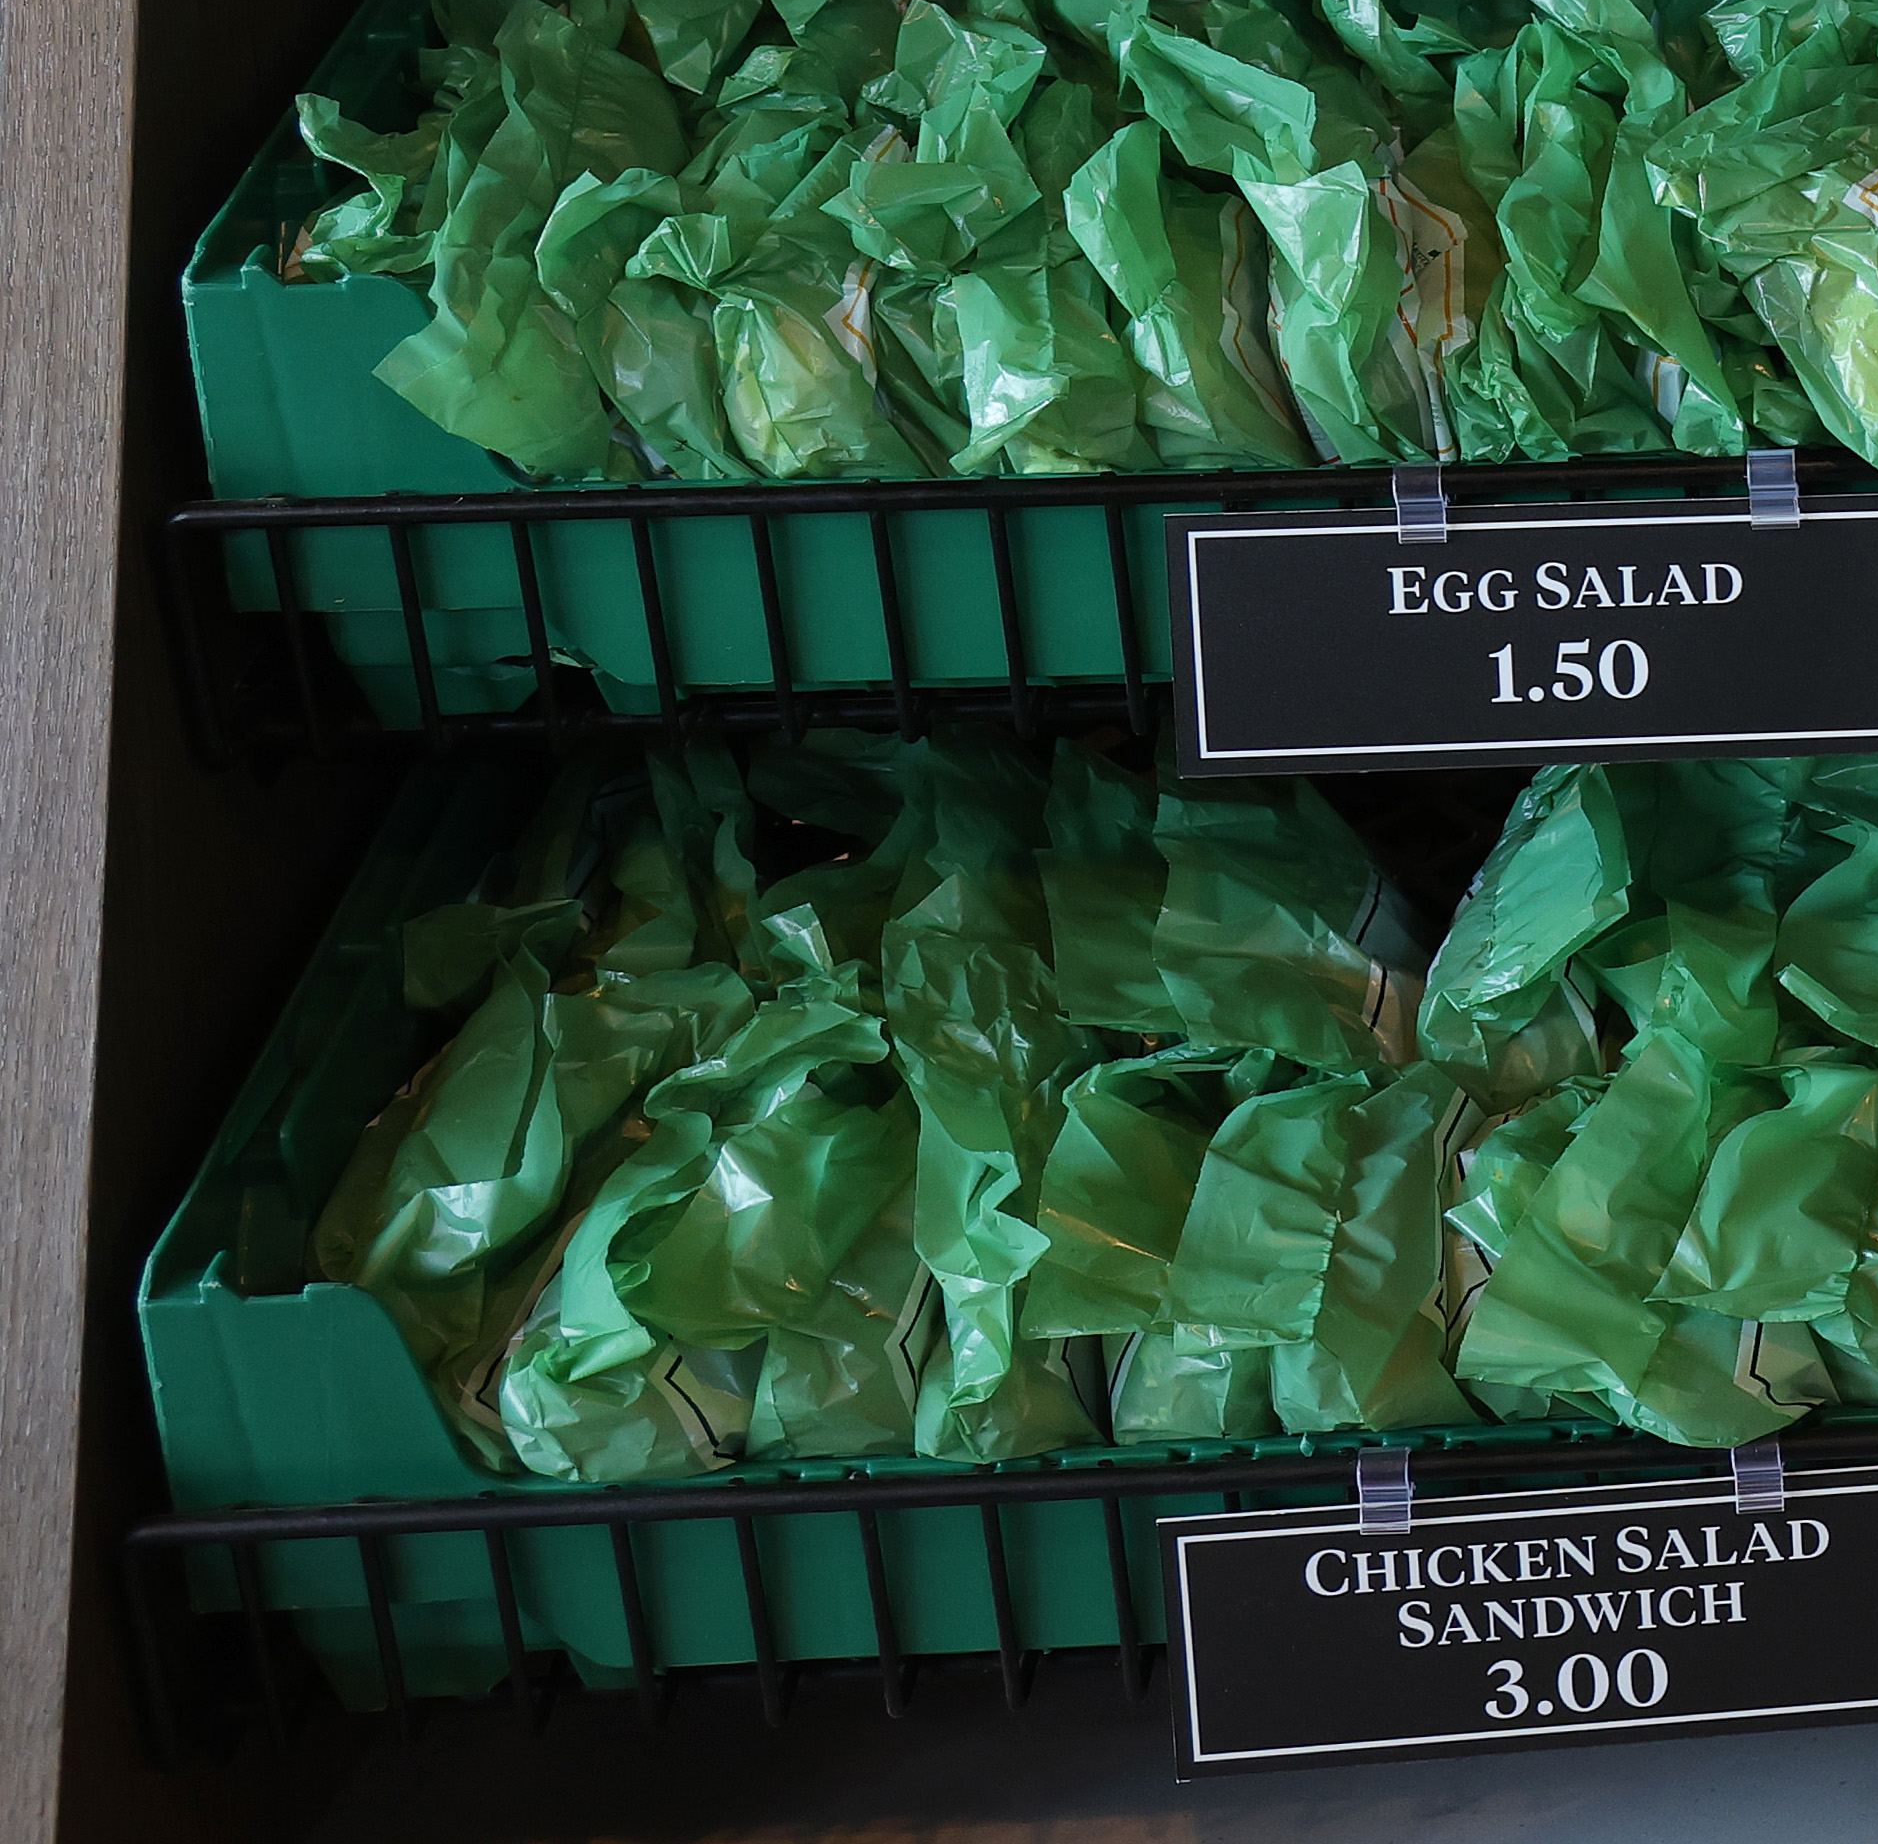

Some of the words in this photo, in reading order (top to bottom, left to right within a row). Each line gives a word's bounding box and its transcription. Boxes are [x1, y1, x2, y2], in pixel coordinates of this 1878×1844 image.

[1386, 566, 1519, 614] EGG
[1536, 562, 1743, 610] SALAD
[1488, 638, 1649, 703] 1.50
[1305, 1535, 1597, 1596] CHICKEN
[1616, 1519, 1830, 1573] SALAD
[1398, 1581, 1747, 1648] SANDWICH
[1485, 1647, 1669, 1719] 3.00
